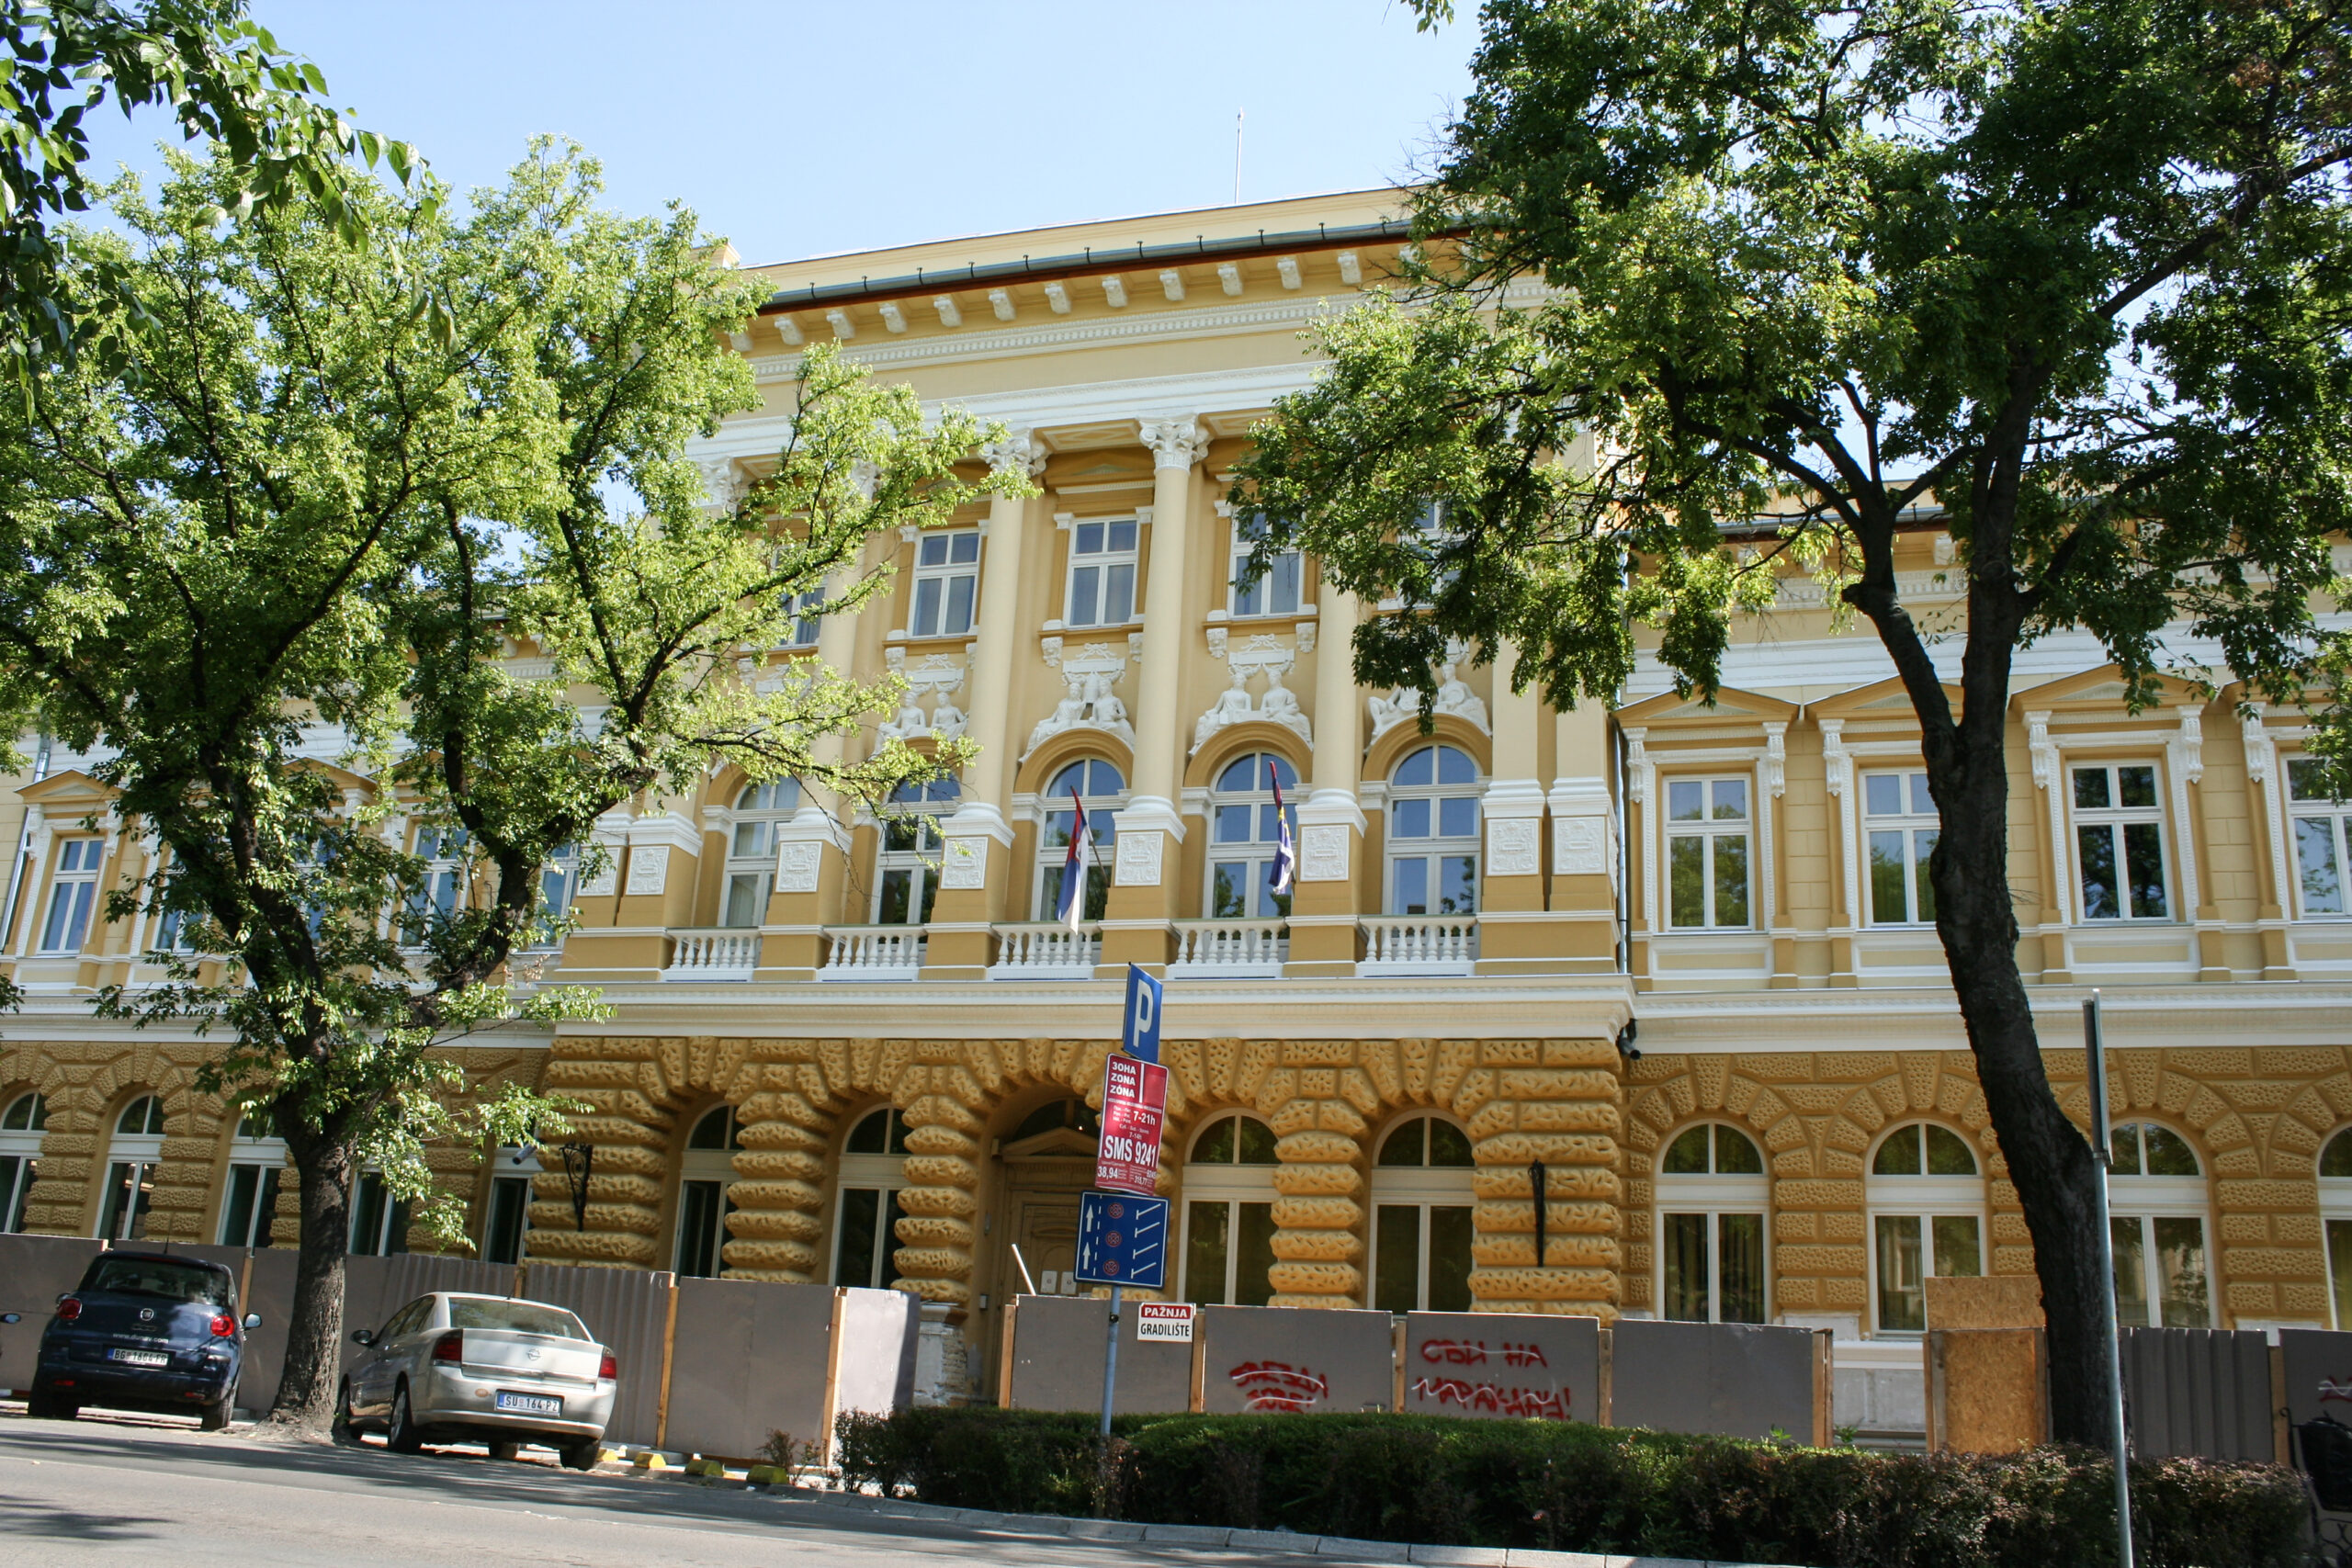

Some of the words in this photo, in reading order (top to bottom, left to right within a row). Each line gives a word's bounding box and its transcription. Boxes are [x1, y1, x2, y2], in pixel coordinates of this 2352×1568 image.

[1133, 978, 1153, 1047] P
[1112, 1061, 1136, 1075] ЗОНА
[1111, 1073, 1136, 1086] ZONA
[1110, 1084, 1135, 1098] ZÓNA
[1133, 1111, 1156, 1125] 7-21h
[1104, 1134, 1132, 1162] SMS
[1135, 1141, 1156, 1168] 9241
[1097, 1166, 1118, 1179] 38,94
[1144, 1306, 1188, 1318] PAŽNJA
[1140, 1323, 1190, 1337] GRADILIŠTE
[114, 1350, 126, 1359] BG
[505, 1396, 518, 1406] SU
